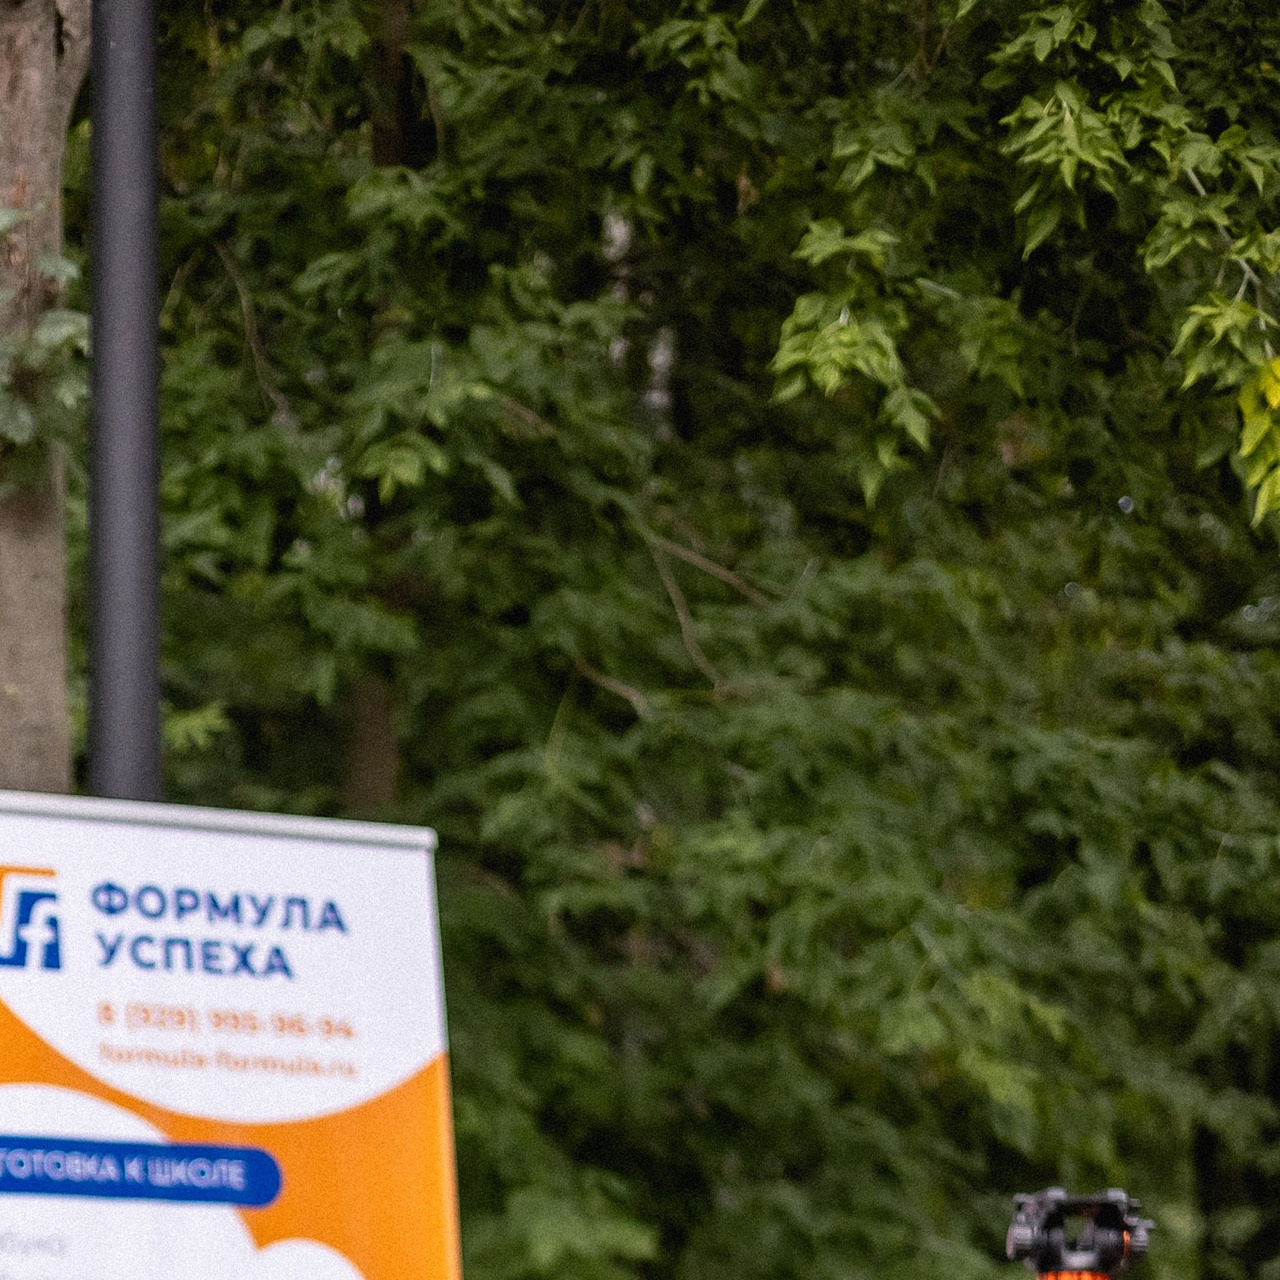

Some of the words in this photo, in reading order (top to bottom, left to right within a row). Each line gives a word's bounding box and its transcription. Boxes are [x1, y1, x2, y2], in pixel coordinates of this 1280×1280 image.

[92, 881, 350, 934] ФОРМУЛА
[96, 932, 295, 981] УСПЕХА
[97, 1001, 116, 1026] 8
[124, 1153, 146, 1184] К
[148, 1154, 248, 1191] ШКОЛЕ
